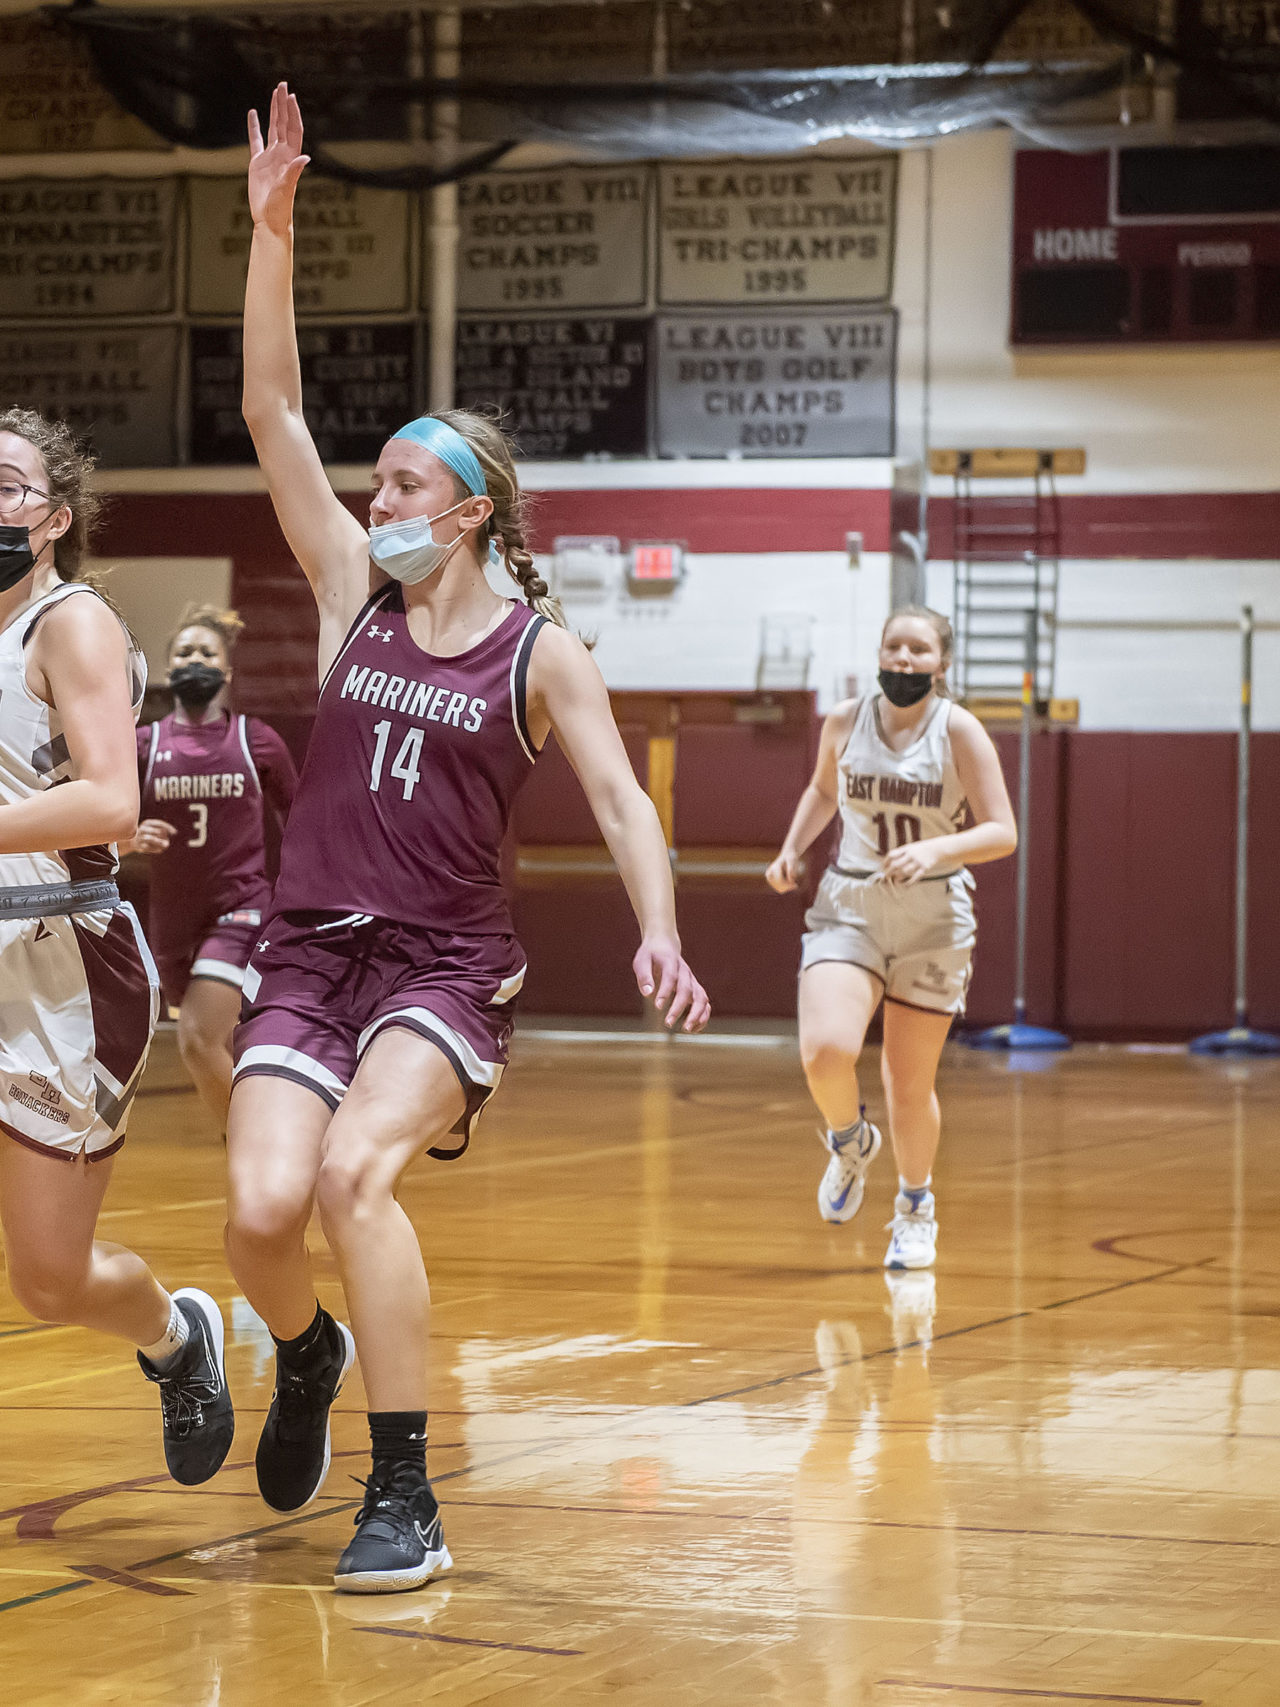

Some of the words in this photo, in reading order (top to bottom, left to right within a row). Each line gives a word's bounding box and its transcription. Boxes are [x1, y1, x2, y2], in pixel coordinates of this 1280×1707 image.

[458, 179, 566, 205] EAGUE
[672, 171, 812, 198] LEAGUE
[471, 211, 596, 237] SOCCER
[467, 243, 600, 269] CHAMPS
[1033, 228, 1119, 262] HOME
[666, 324, 807, 352] LEAGUE
[823, 324, 886, 350] VIII
[677, 357, 768, 384] BOYS
[780, 357, 872, 383] GOLF
[703, 390, 845, 416] CHAMPS
[740, 422, 808, 448] 2007
[340, 664, 489, 734] MARINERS
[369, 719, 426, 801] 14
[154, 772, 245, 801] MARINERS
[187, 803, 209, 849] 3
[8, 1083, 71, 1125] BONACKERS
